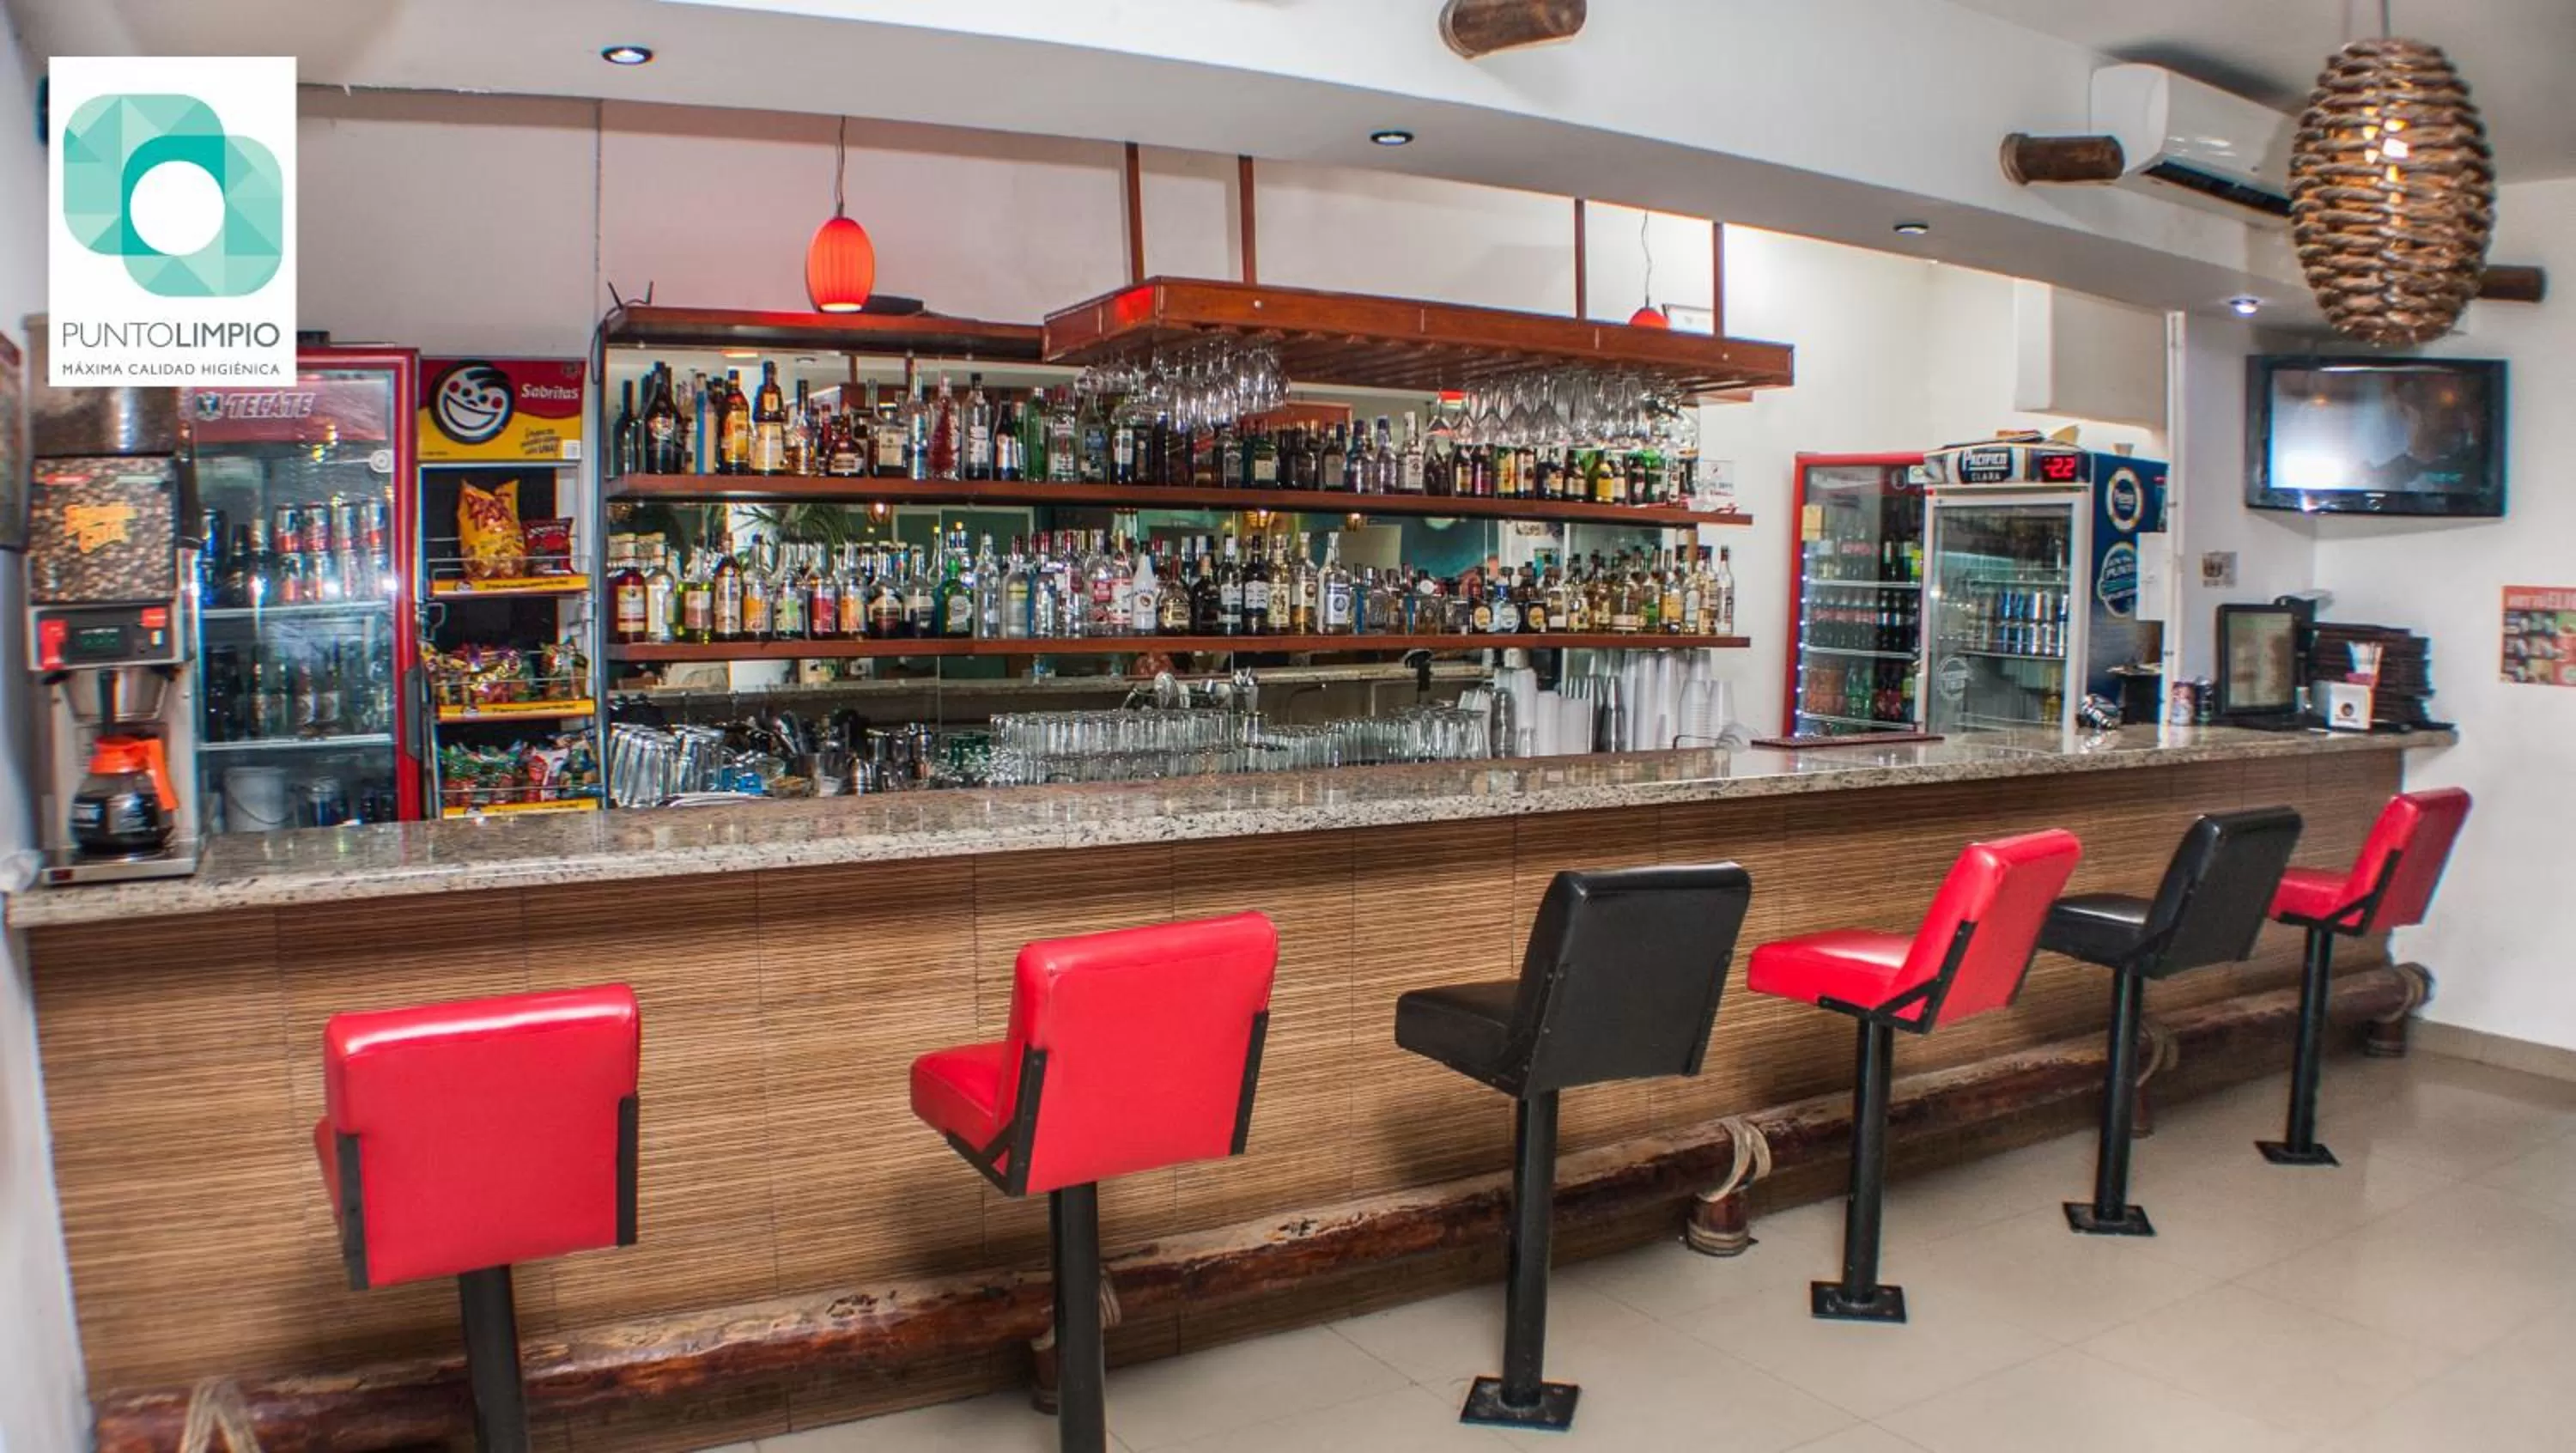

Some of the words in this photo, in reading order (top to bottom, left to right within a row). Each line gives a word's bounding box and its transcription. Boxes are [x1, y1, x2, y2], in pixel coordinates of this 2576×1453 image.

[520, 383, 579, 400] Sabritas
[225, 392, 316, 419] TECATE
[1971, 472, 2002, 483] CLARA
